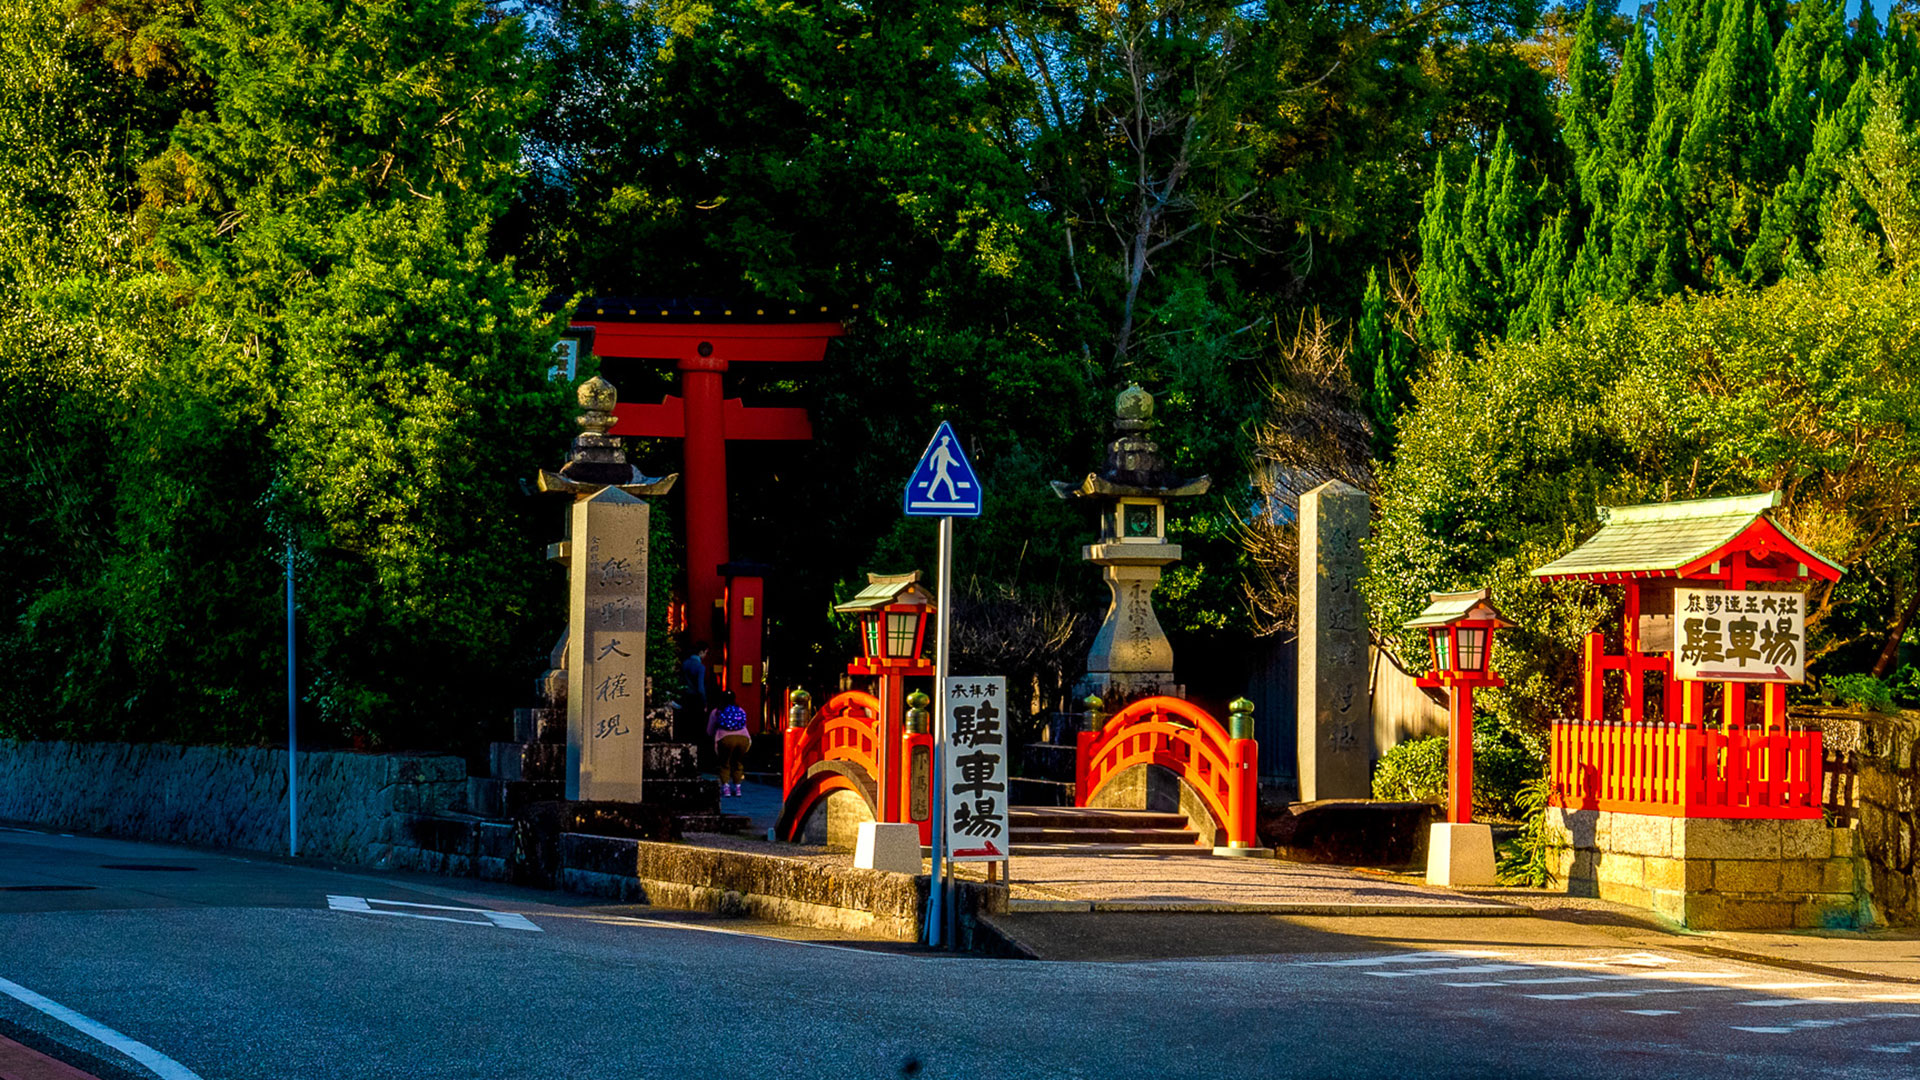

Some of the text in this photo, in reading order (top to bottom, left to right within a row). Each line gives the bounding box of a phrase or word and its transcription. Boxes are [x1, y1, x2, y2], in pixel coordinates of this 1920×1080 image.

[1684, 593, 1798, 616] 熊野速玉大社
[1681, 615, 1800, 667] 駐車場
[951, 683, 999, 699] 参拝者
[951, 699, 1005, 839] 駐車場
